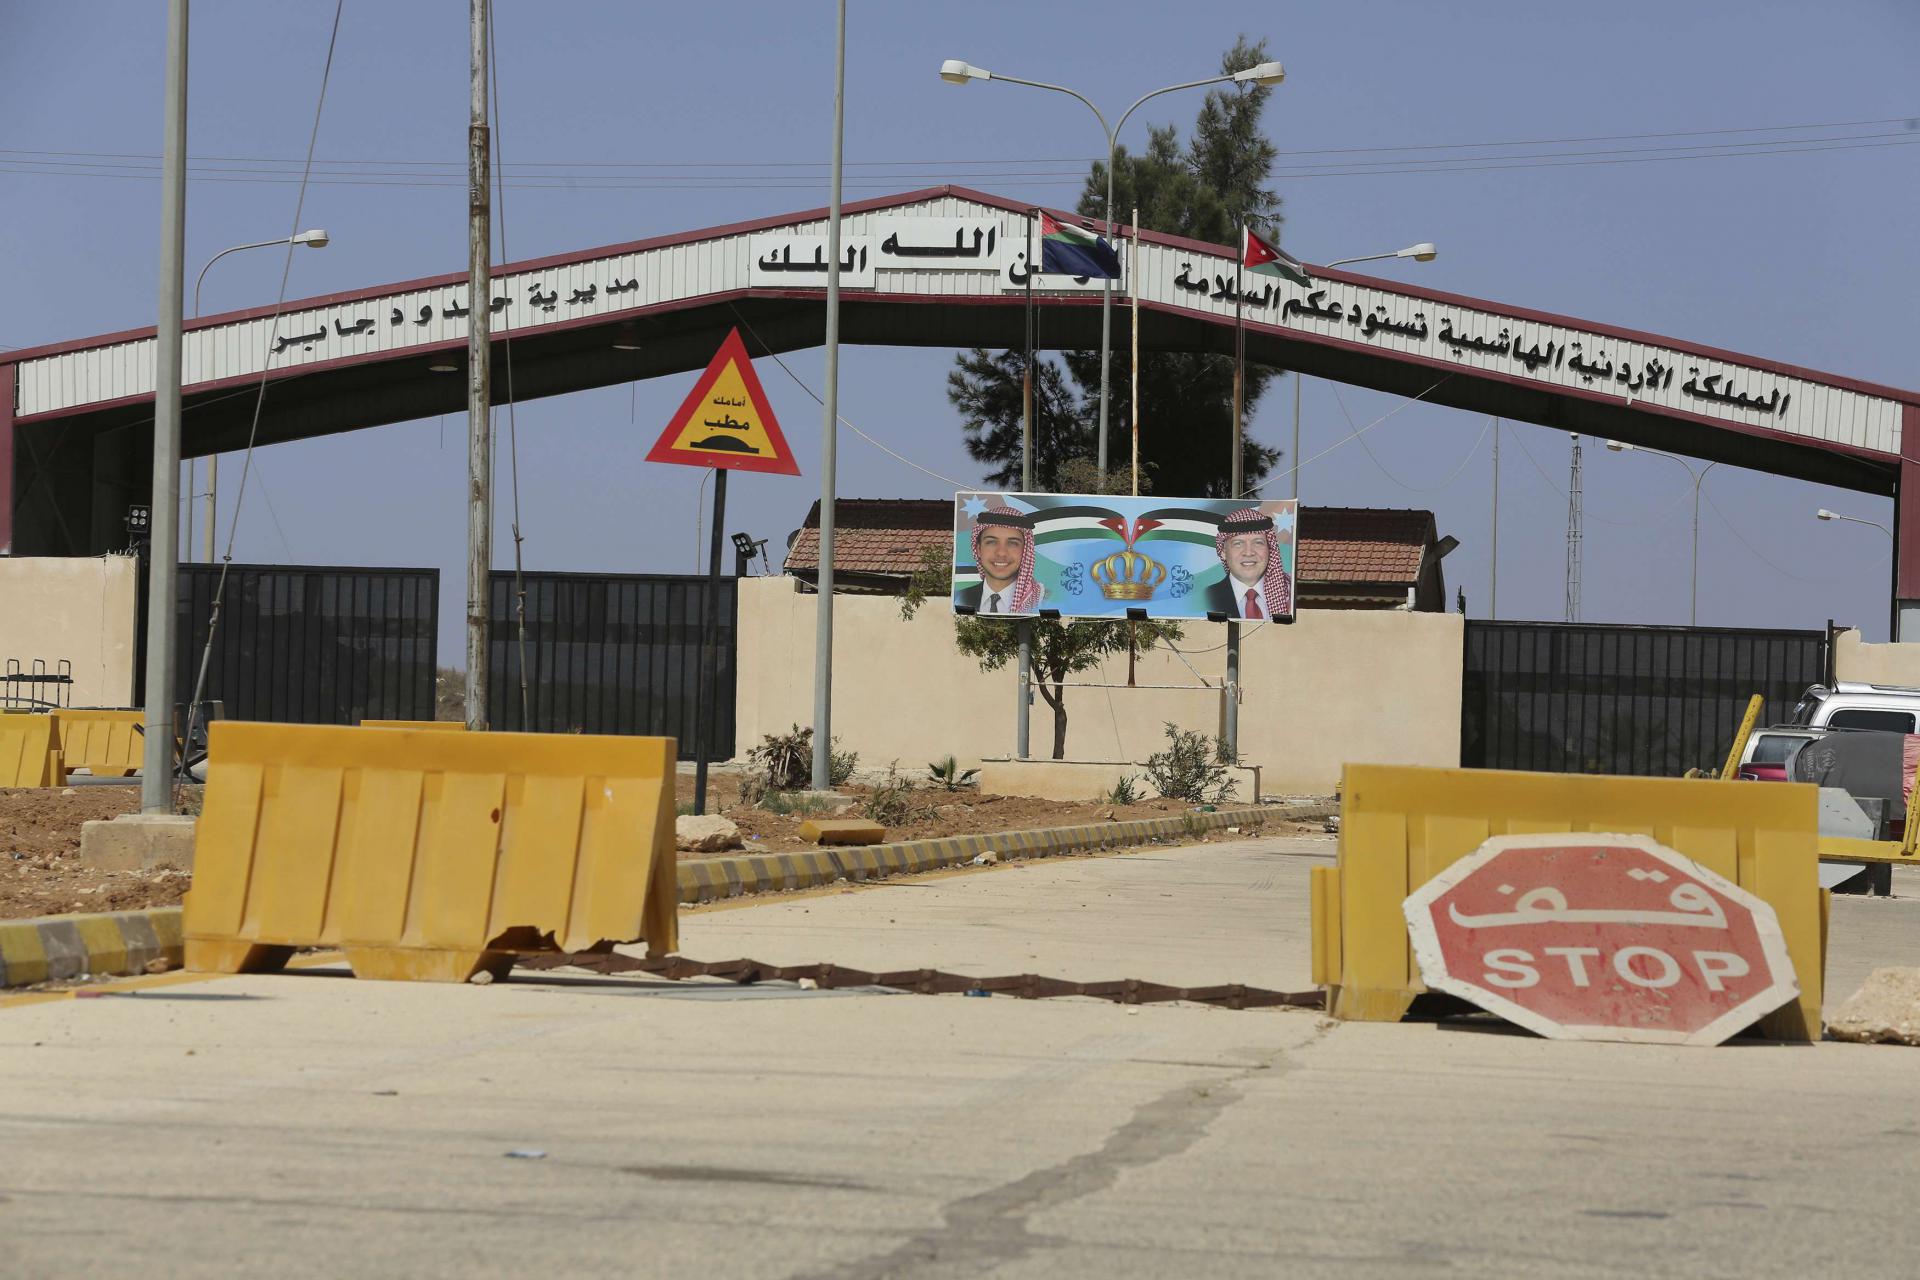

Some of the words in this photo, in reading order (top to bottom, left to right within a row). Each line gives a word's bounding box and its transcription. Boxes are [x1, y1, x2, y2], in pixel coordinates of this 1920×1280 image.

[758, 244, 867, 273] اللك
[881, 225, 995, 258] الله
[528, 278, 639, 312] مديرية
[1174, 262, 1280, 311] السلامة
[391, 297, 513, 325] حدود
[1282, 290, 1428, 339] تستودعكم
[272, 318, 375, 354] جابر
[1438, 317, 1566, 370] الهاشمية
[1568, 342, 1673, 391] الأردنية
[713, 397, 746, 407] أمامك
[1682, 366, 1791, 416] المملكة
[704, 414, 750, 431] مطب
[1449, 868, 1728, 929] قف
[1483, 946, 1750, 992] STOP
